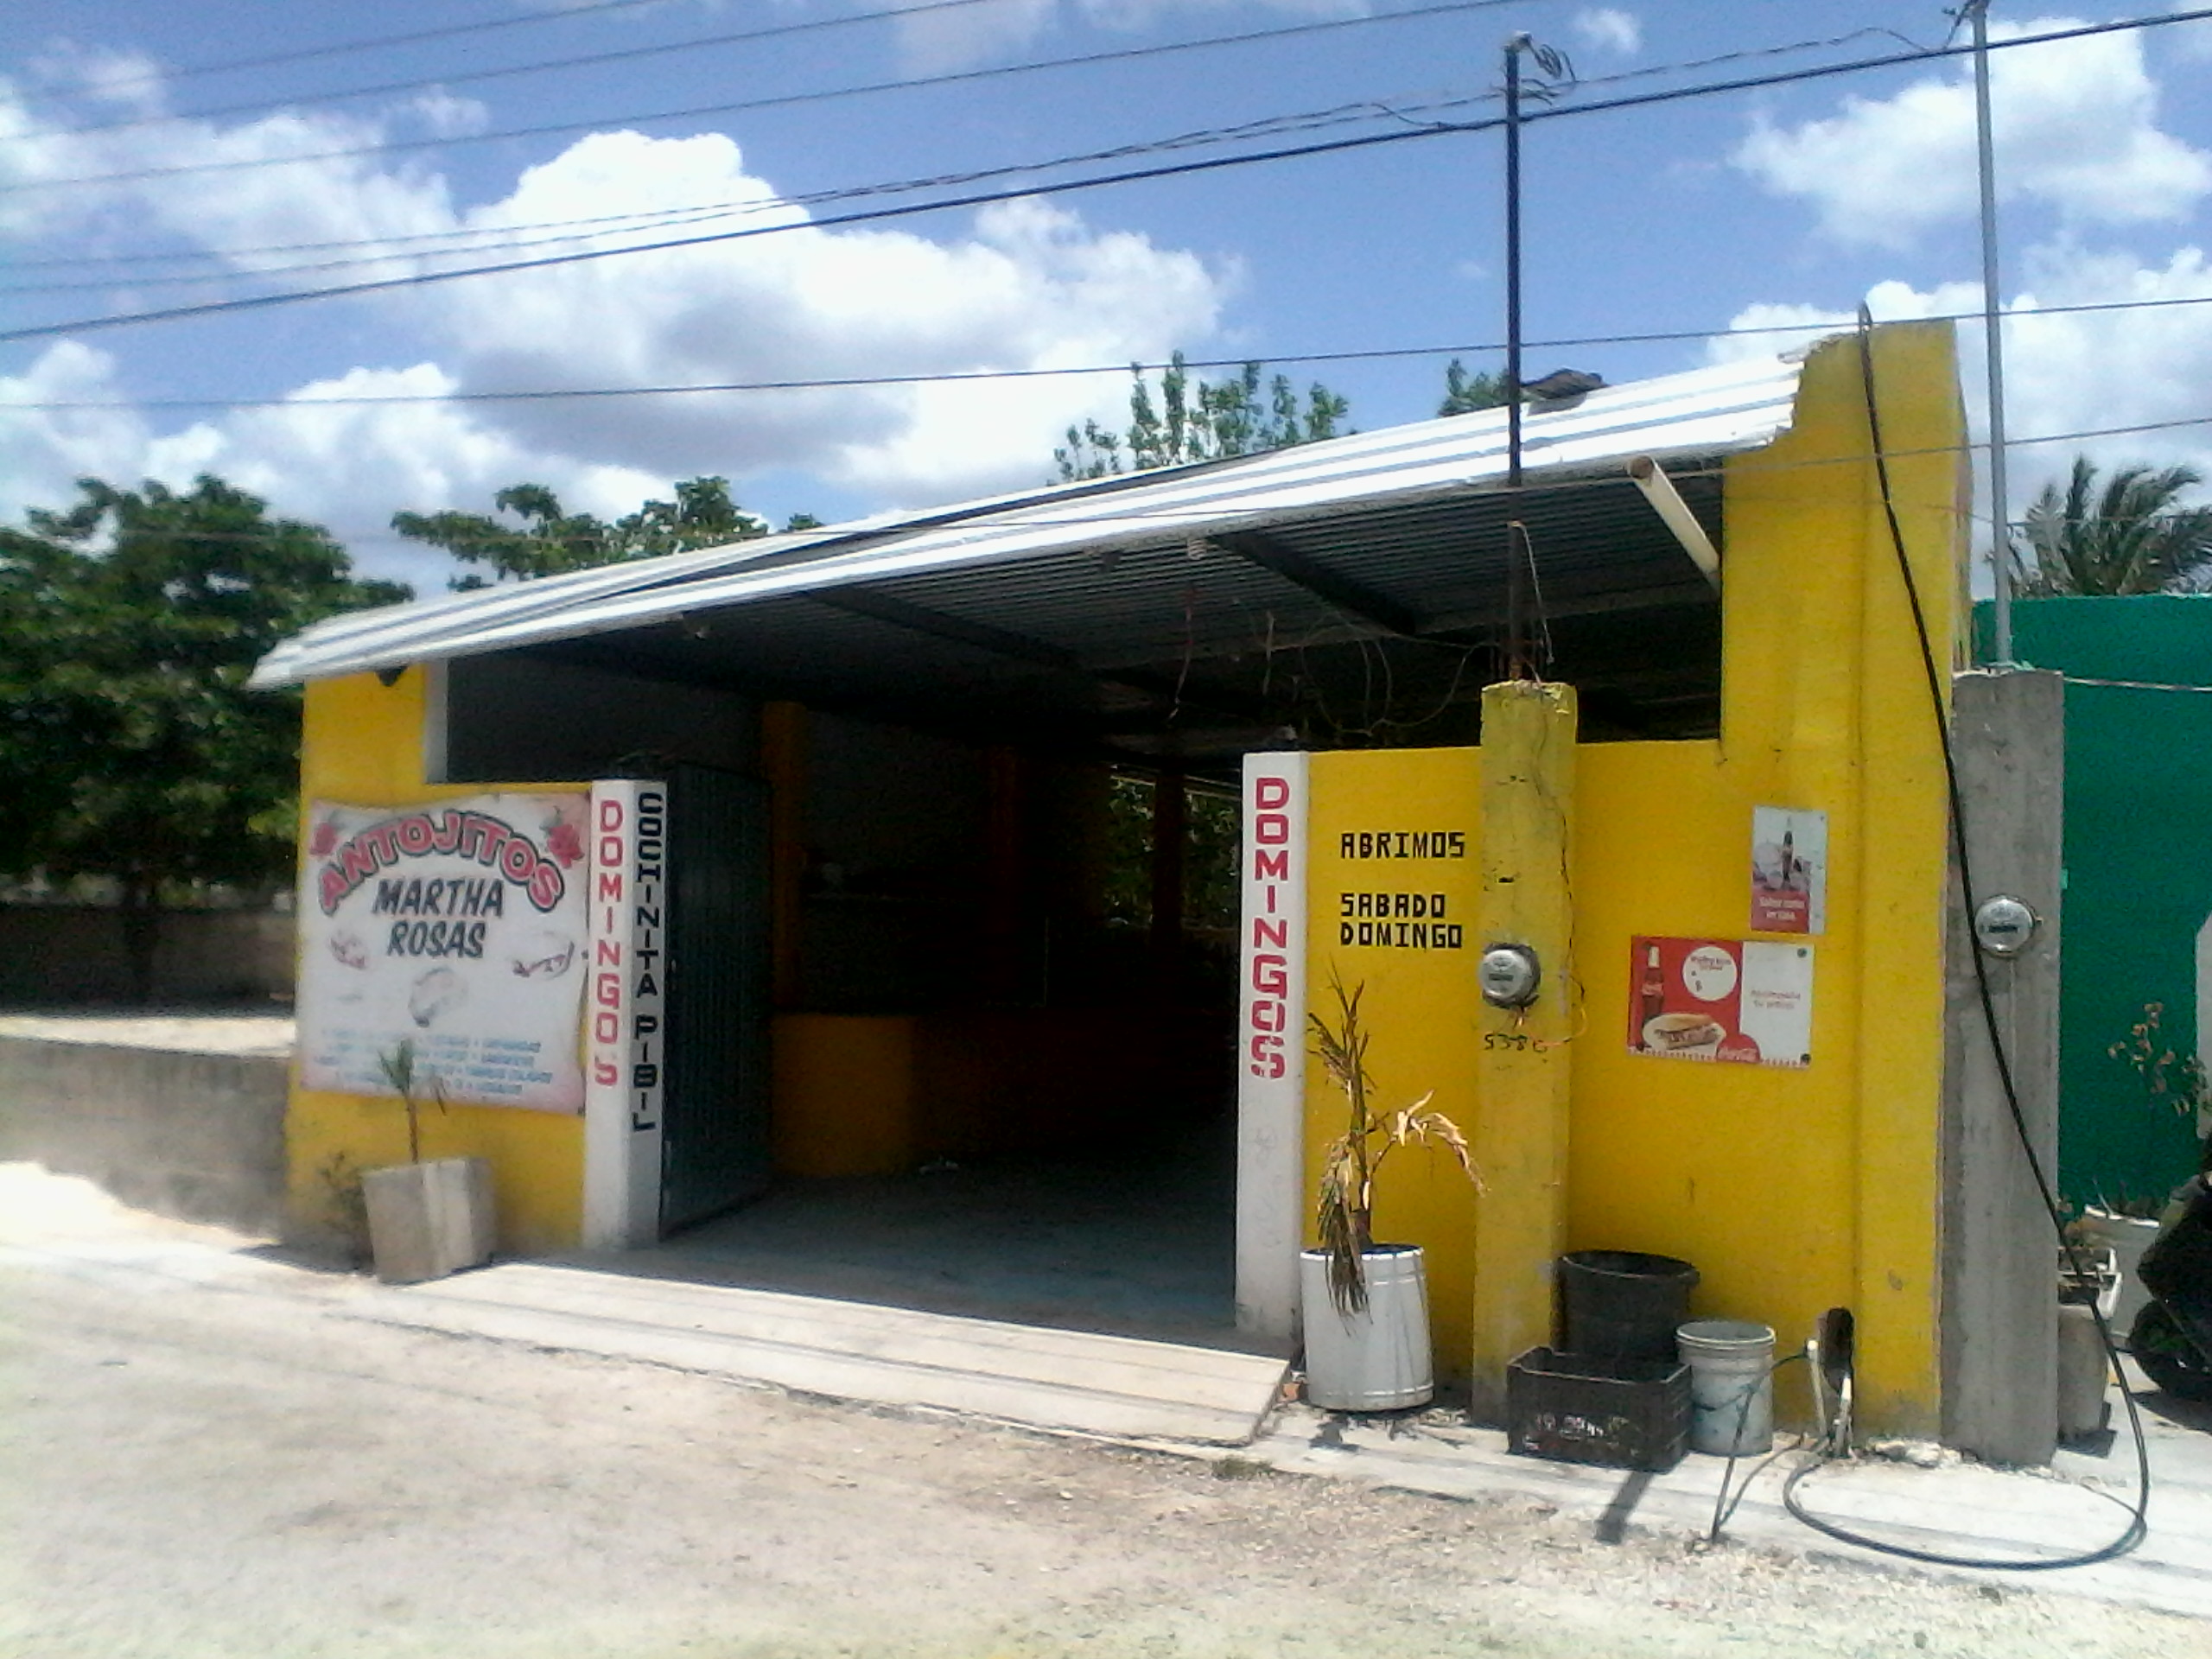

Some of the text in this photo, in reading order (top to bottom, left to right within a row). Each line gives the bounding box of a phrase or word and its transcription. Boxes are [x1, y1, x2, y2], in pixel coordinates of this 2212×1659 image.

[318, 809, 565, 917] ANTOJITOS
[1340, 832, 1465, 859] ABRIMOS
[372, 877, 505, 918] MARTHA
[1340, 893, 1446, 918] SABADO
[386, 920, 486, 958] ROSAS
[594, 799, 624, 1087] DOMINGOS
[1250, 777, 1290, 1079] DOMINGOS
[1340, 922, 1463, 950] DOMINGO
[632, 792, 663, 1132] COCHINITA PIBIL
